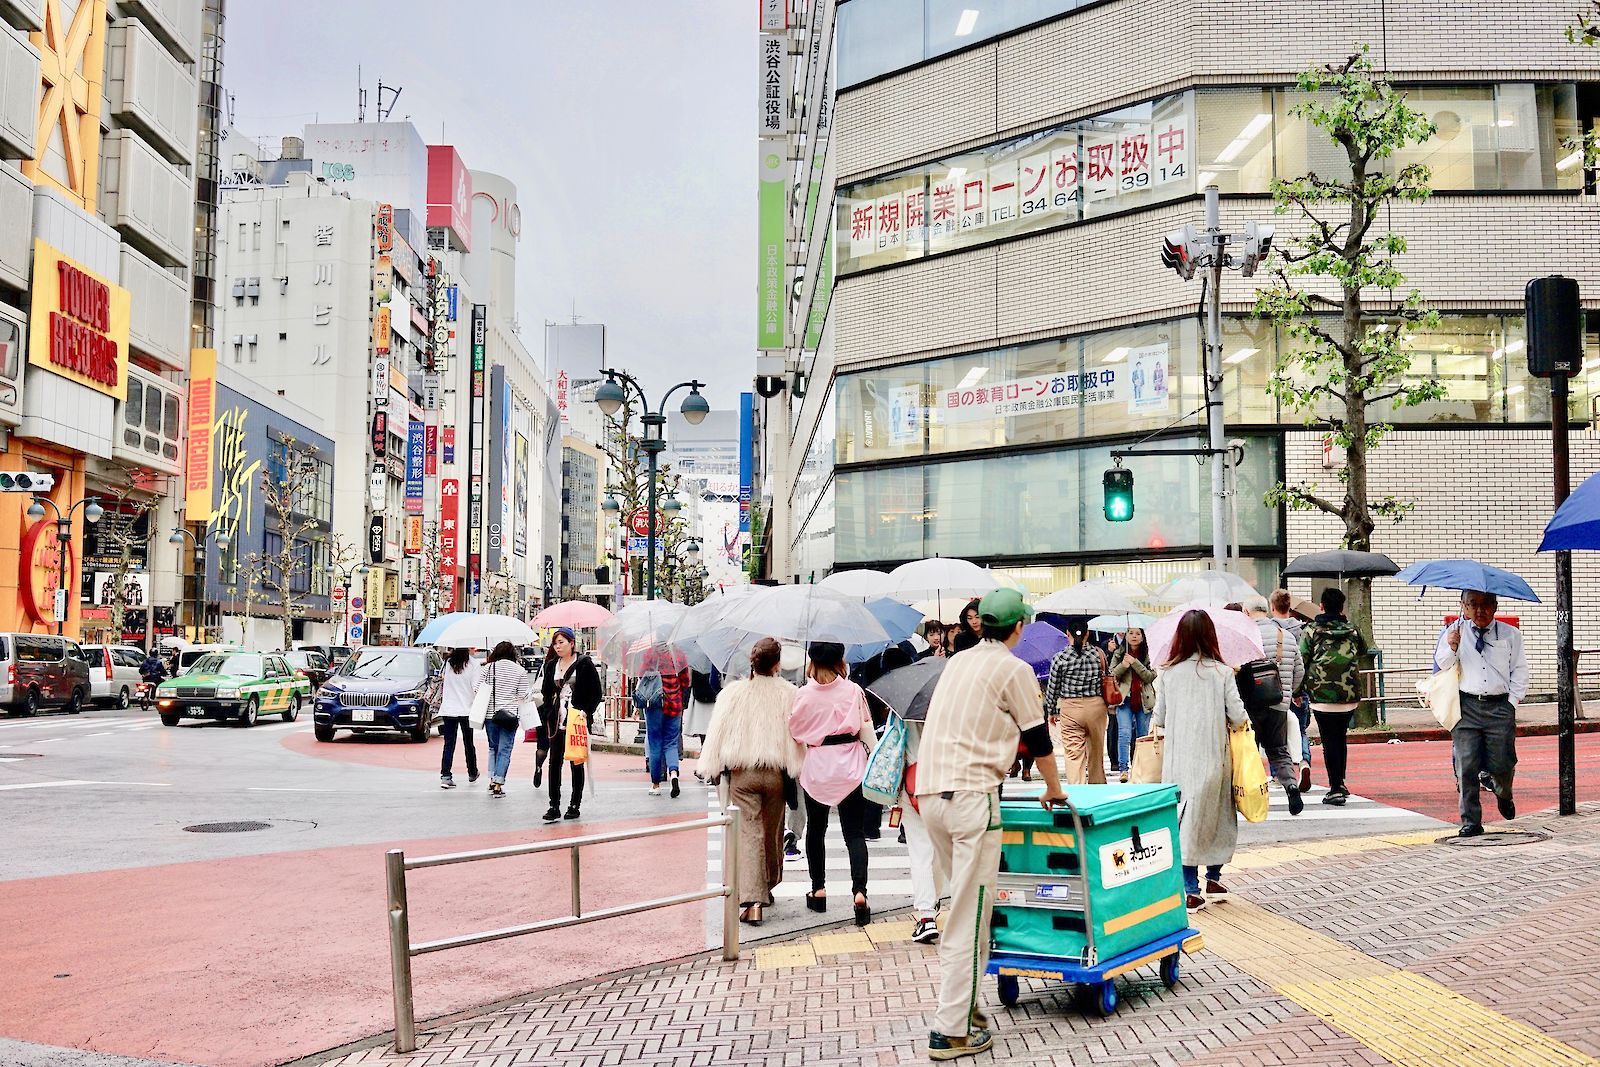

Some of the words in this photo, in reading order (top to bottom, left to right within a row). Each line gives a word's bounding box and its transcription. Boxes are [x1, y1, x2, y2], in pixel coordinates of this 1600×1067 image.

[765, 39, 781, 130] 渋谷公証役場
[852, 124, 1185, 240] 新規開業ローンお取扱中
[992, 205, 1015, 221] TEL
[57, 259, 111, 333] TOWER
[766, 244, 778, 334] 日本政策金融公庫
[49, 311, 118, 387] RECORDS
[191, 377, 211, 426] TOWER
[557, 369, 568, 411] 大和証券
[947, 369, 1115, 408] 国の教育ローンお取扱中
[189, 428, 210, 492] RECORDS
[411, 432, 424, 479] 渋谷整形
[635, 517, 650, 528] 消火
[740, 485, 751, 523] SEIBU
[545, 560, 553, 591] ZARA
